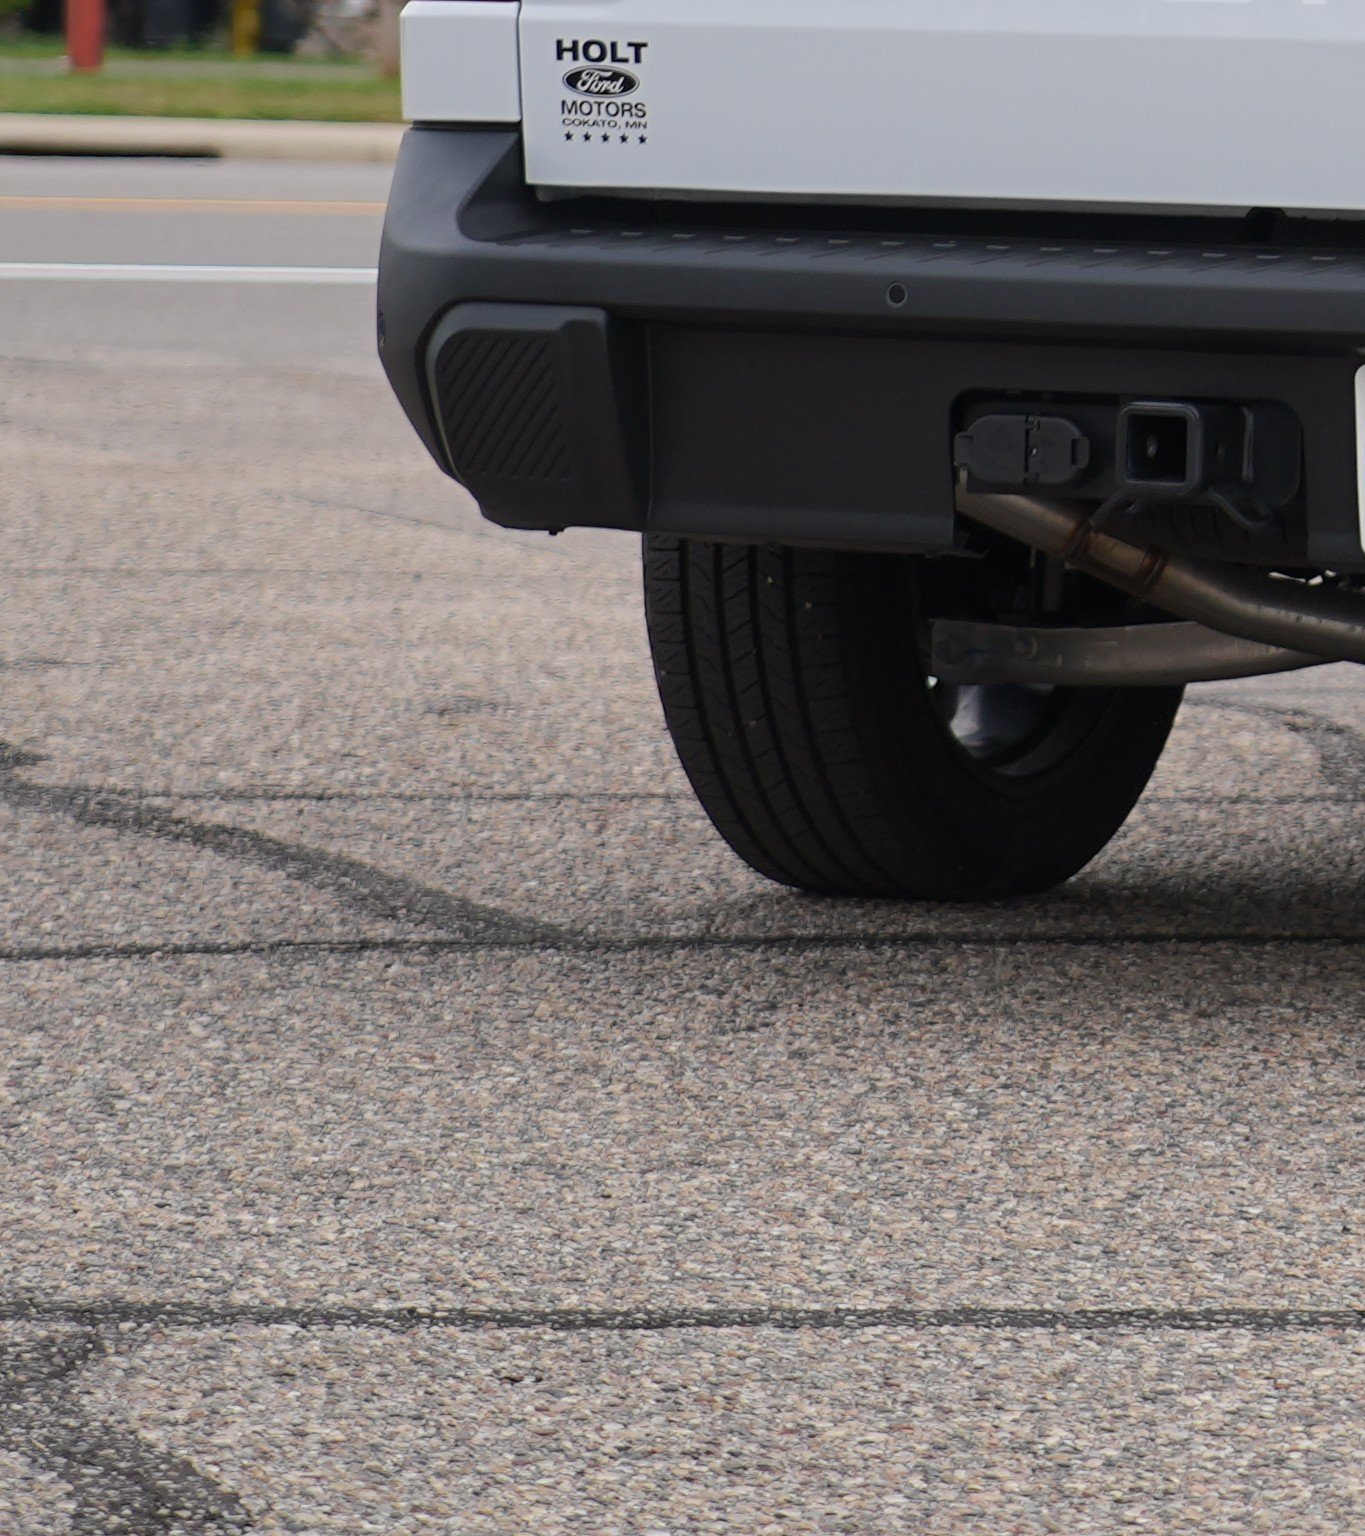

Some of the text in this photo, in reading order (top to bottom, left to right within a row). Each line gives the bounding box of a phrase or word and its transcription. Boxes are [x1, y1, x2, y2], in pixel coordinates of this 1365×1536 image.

[555, 38, 649, 64] HOLT
[576, 68, 625, 94] Ford
[561, 100, 647, 118] MOTORS
[562, 118, 648, 130] COKATO, MN
